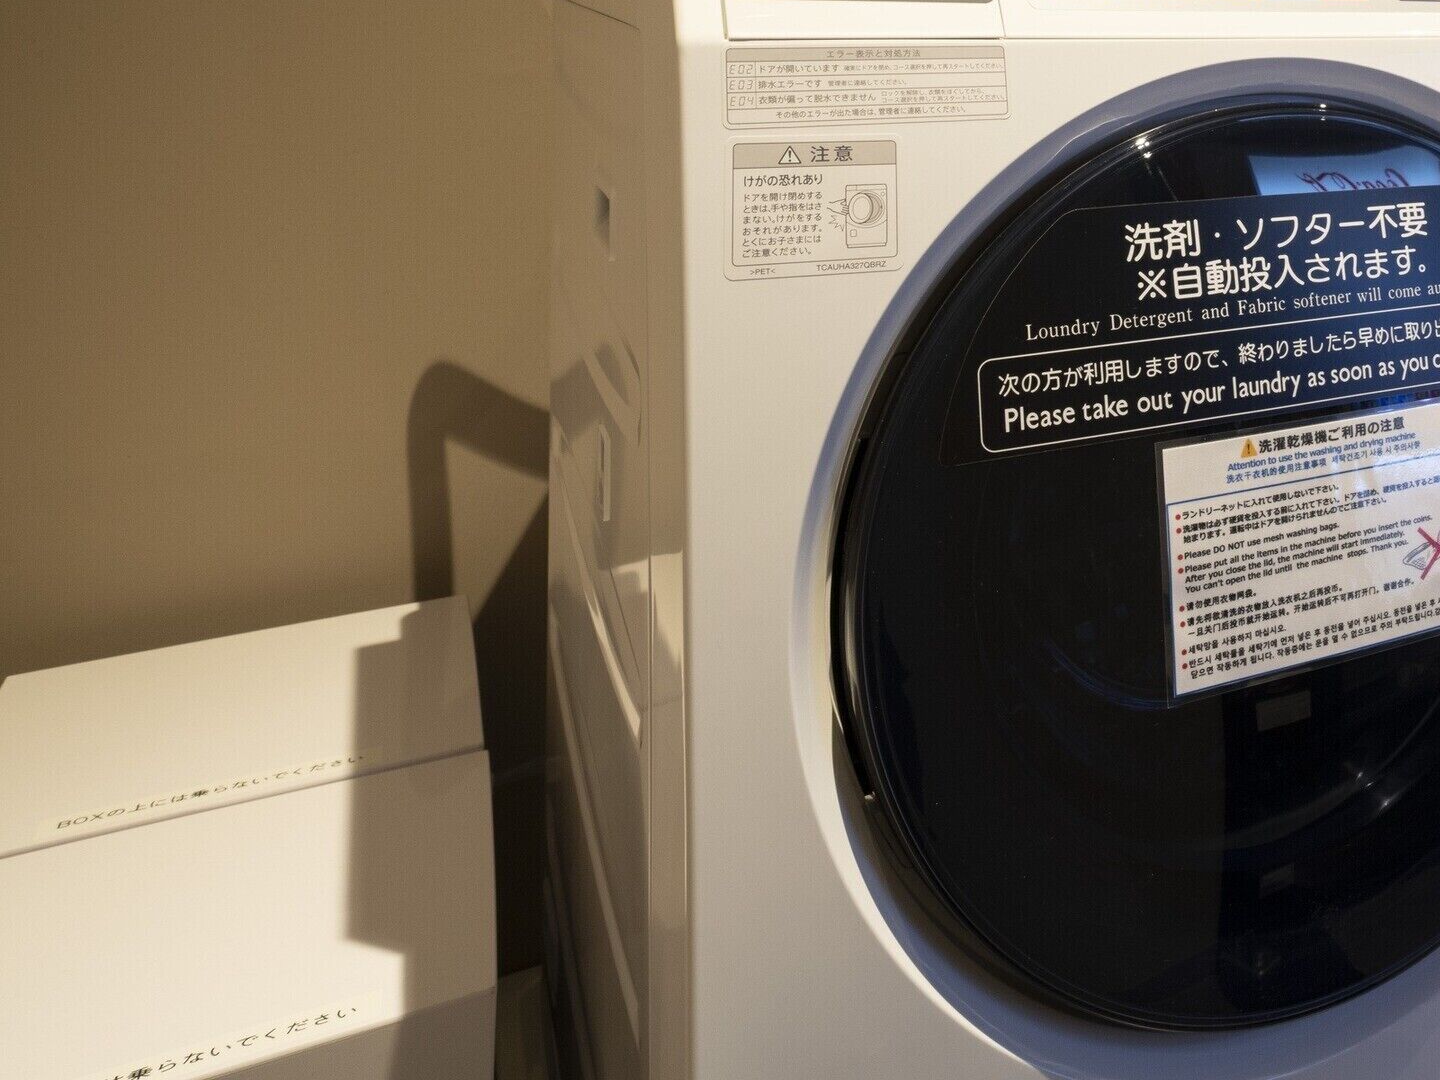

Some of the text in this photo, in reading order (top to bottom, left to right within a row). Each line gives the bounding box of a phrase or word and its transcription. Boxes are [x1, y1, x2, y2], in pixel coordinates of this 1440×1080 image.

[827, 49, 921, 59] エラー表示と対処方法
[759, 64, 839, 75] ドアが開いています
[758, 79, 821, 89] 排水エラーです
[758, 93, 877, 105] 衣類が偏って脱水できません
[810, 145, 854, 163] 注意
[743, 173, 824, 187] けがの恐れあり
[743, 191, 823, 203] ドアを開け閉めする
[743, 203, 822, 214] ときは、手や指をはさ
[743, 213, 822, 225] まない。けがをする
[742, 225, 822, 237] おそれがあります。
[1125, 202, 1428, 262] 洗剤・ソフター不要
[742, 235, 821, 247] とくにお子さまには
[742, 247, 812, 258] ご注意ください。
[1138, 245, 1426, 300] ※自動投入されます。
[1025, 320, 1100, 341] Loundry
[1110, 308, 1193, 332] Detergent
[1201, 302, 1230, 320] and
[1238, 296, 1286, 317] Fabric
[1293, 290, 1351, 309] softener
[1357, 287, 1382, 303] will
[1388, 284, 1421, 300] come
[1004, 404, 1076, 433] Please
[1082, 395, 1128, 421] take
[1137, 392, 1173, 413] out
[1181, 385, 1225, 415] your
[1233, 370, 1301, 398] laundry
[1308, 370, 1326, 387] as
[1331, 362, 1372, 384] soon
[1378, 359, 1396, 377] as
[1400, 355, 1429, 380] you
[1259, 416, 1405, 453] 洗濯乾燥機ご利用の注意
[1227, 460, 1267, 471] Attention
[1278, 454, 1293, 463] use
[1295, 451, 1308, 460] the
[1309, 444, 1342, 457] washing
[1344, 441, 1358, 451] and
[1360, 437, 1384, 449] drying
[1385, 432, 1416, 443] machine
[1184, 522, 1340, 559] Please DO NOT use mesh washing bags.
[1184, 562, 1212, 573] Please
[1213, 559, 1228, 569] put
[1229, 556, 1240, 564] all
[1241, 553, 1255, 561] the
[1256, 549, 1279, 558] items
[1290, 543, 1303, 551] the
[1304, 535, 1336, 548] machine
[1338, 530, 1362, 541] before
[1363, 528, 1377, 539] you
[1378, 521, 1399, 531] insert
[1400, 517, 1412, 526] the
[1413, 514, 1433, 523] coins.
[57, 754, 364, 829] BOXの上には乗らないでください
